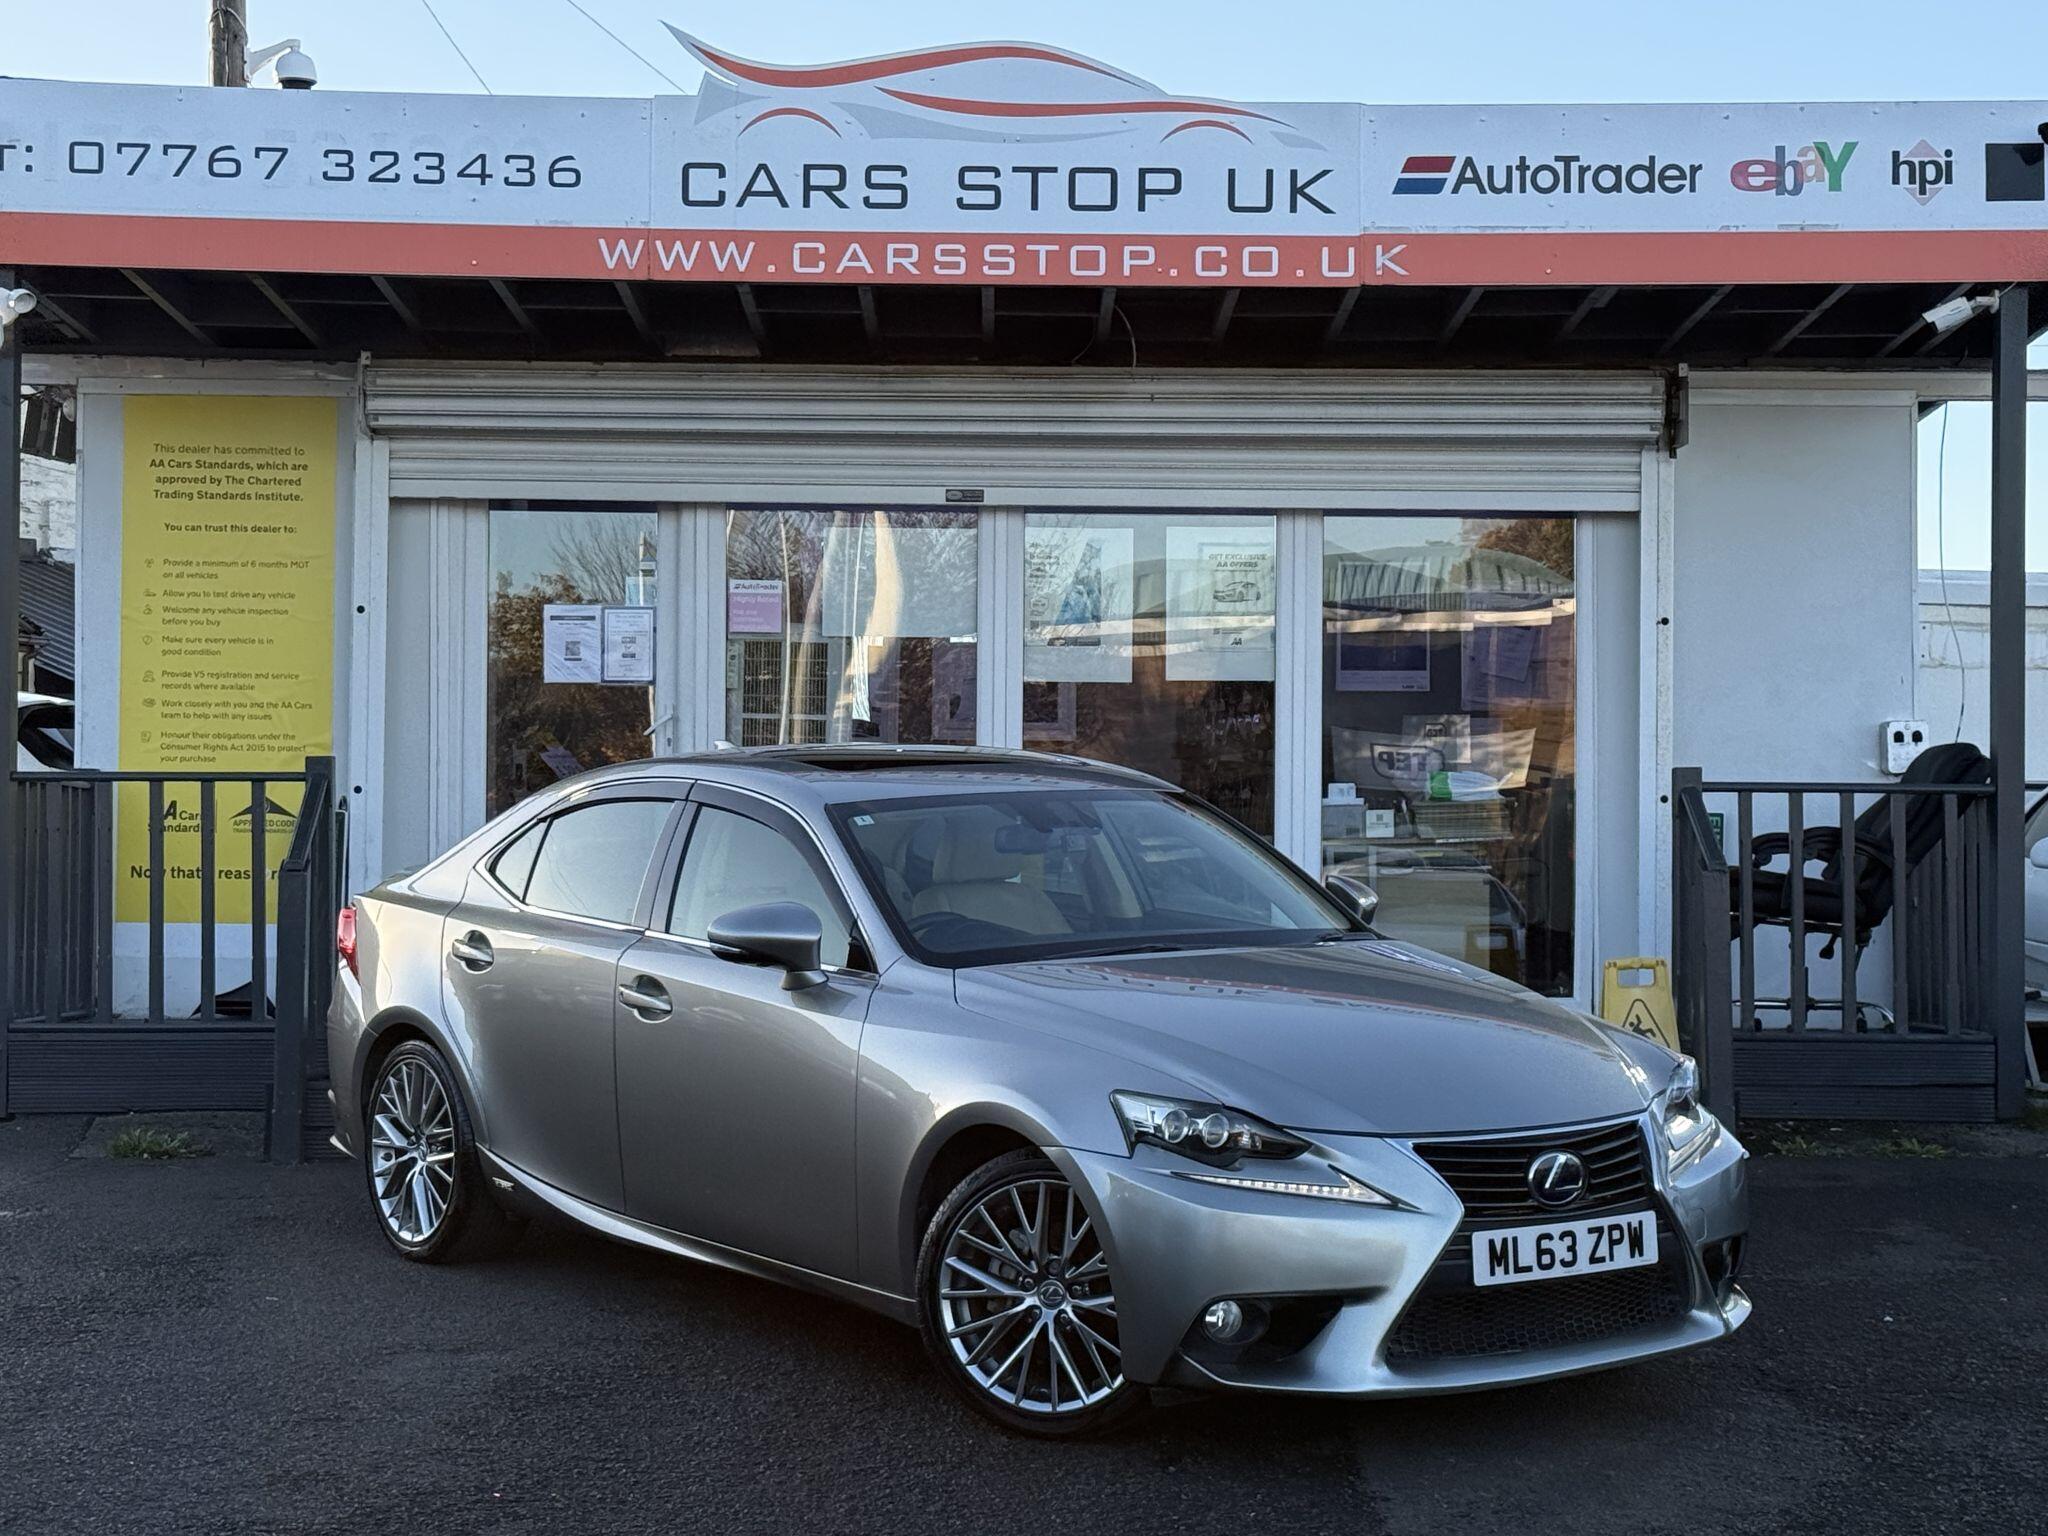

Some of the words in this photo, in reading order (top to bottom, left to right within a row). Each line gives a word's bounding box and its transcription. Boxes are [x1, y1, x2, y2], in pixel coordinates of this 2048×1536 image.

[68, 141, 289, 180] 07767
[321, 148, 582, 189] 323436
[1451, 154, 1704, 196] AutoTrader
[1891, 148, 1955, 196] hpi
[681, 162, 910, 210] CARS
[956, 165, 1182, 212] STOP
[1227, 167, 1336, 215] UK
[154, 443, 175, 452] This
[178, 444, 211, 454] dealer
[214, 445, 232, 454] has
[235, 445, 291, 455] committed
[295, 446, 304, 455] to
[150, 459, 165, 467] AA
[168, 459, 192, 468] Cars
[195, 460, 254, 470] Standards,
[257, 461, 288, 470] which
[156, 475, 206, 485] approved
[209, 475, 222, 486] by
[225, 475, 244, 484] The
[248, 476, 301, 485] Chartered
[154, 489, 193, 500] Trading
[197, 490, 252, 500] Standards
[255, 491, 303, 501] Institute.
[164, 522, 182, 531] You
[205, 523, 228, 532] trust
[231, 523, 248, 532] this
[251, 524, 281, 533] dealer
[284, 524, 297, 533] to:
[186, 571, 218, 579] vehicles
[163, 589, 184, 597] Allow
[187, 591, 200, 600] you
[213, 590, 228, 598] test
[230, 590, 250, 598] drive
[252, 592, 266, 600] any
[268, 590, 295, 599] vehicle
[162, 606, 200, 614] Welcome
[202, 607, 215, 615] any
[219, 606, 245, 614] vehicle
[248, 607, 288, 616] inspection
[162, 617, 187, 625] before
[207, 618, 220, 626] buy
[162, 635, 183, 643] Make
[228, 636, 255, 644] vehicle
[162, 648, 182, 656] good
[184, 648, 221, 656] condition
[194, 682, 218, 690] where
[221, 682, 255, 690] available
[180, 755, 216, 763] purchase
[1488, 1229, 1579, 1278] ML63
[1586, 1219, 1645, 1266] ZPW
